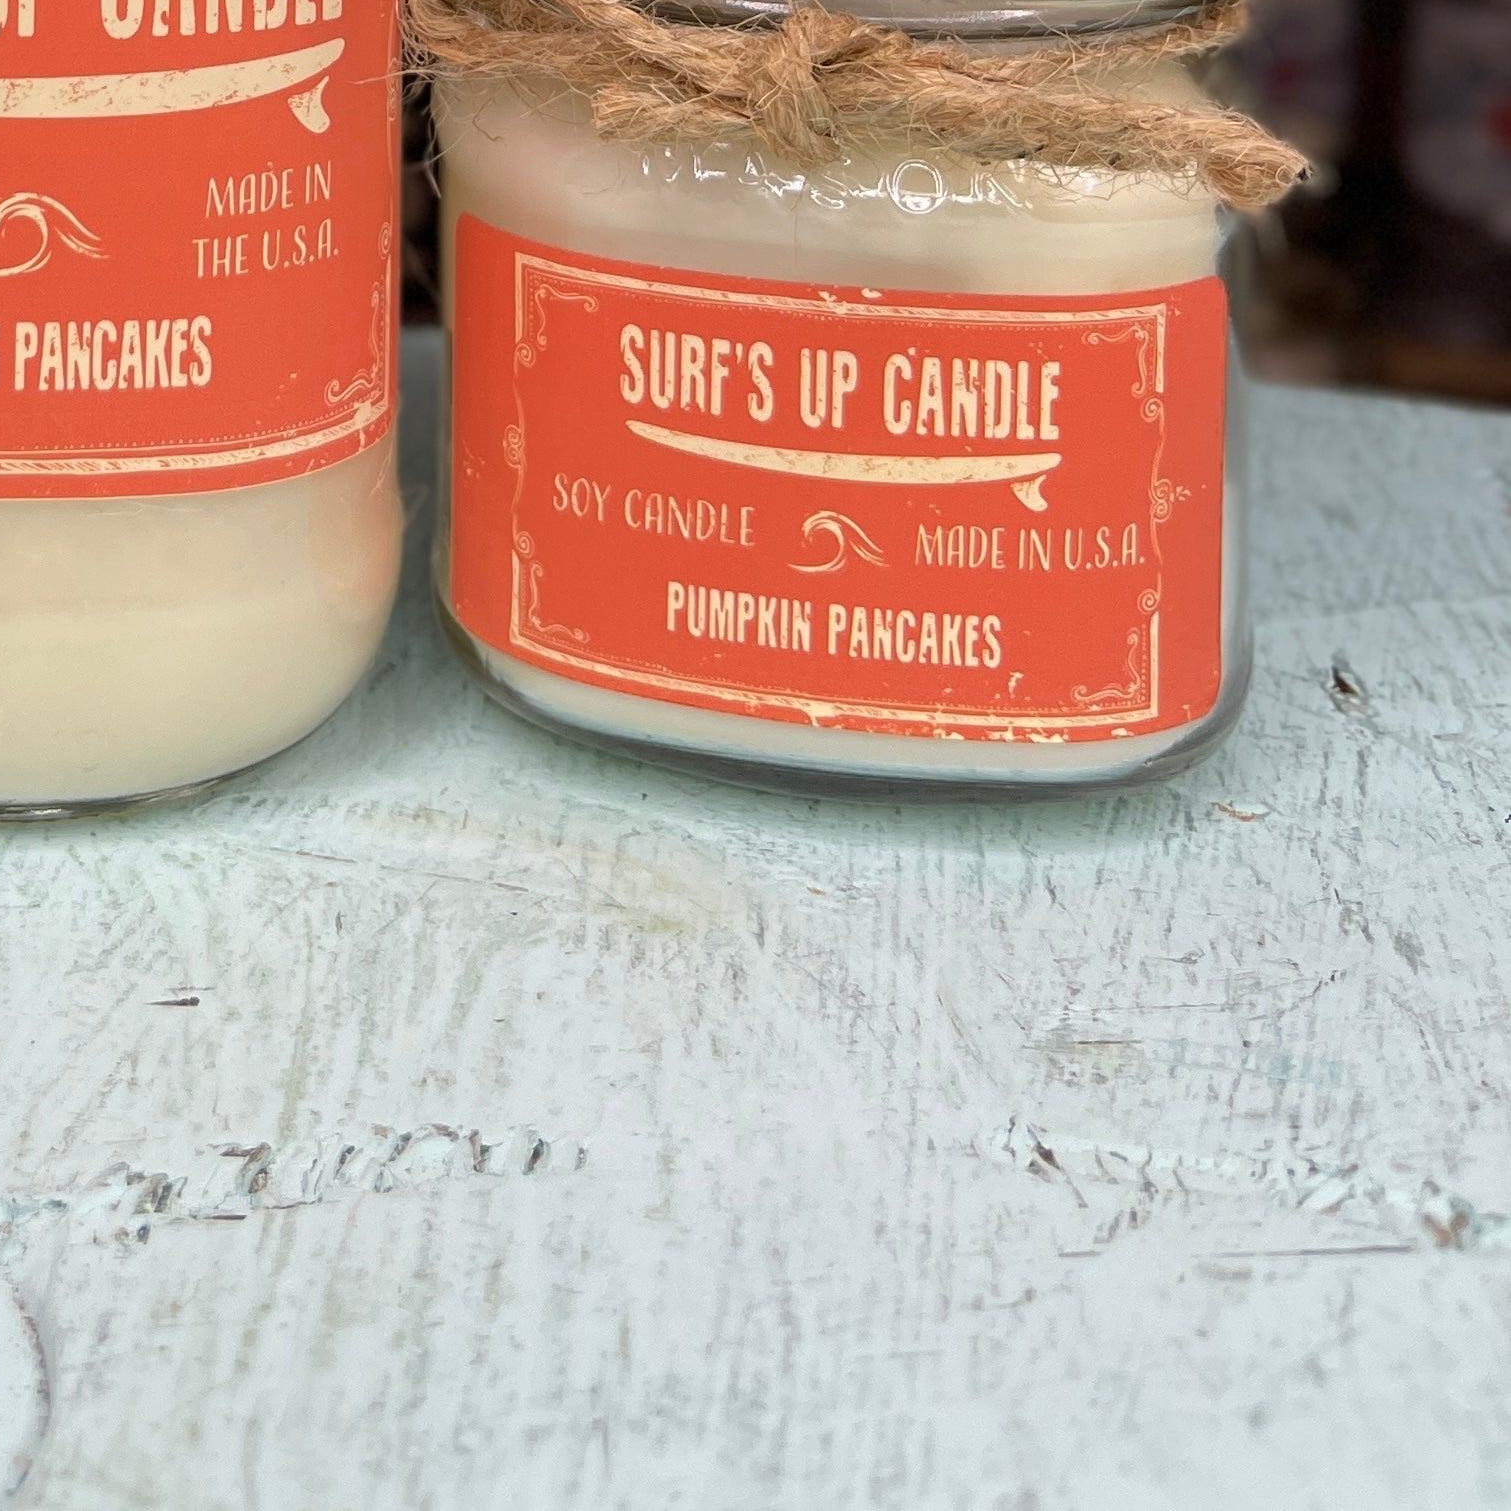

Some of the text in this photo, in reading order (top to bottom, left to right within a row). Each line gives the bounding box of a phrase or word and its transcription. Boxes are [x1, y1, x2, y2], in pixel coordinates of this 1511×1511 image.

[205, 160, 331, 218] MADE IN
[192, 219, 339, 278] THE U.S.A.
[14, 315, 212, 391] PANCAKES
[620, 323, 1061, 441] SURF'S UP CANDLE
[553, 473, 755, 547] SOY CANDLE
[915, 523, 1145, 571] MADE IN U.S.A.
[667, 581, 1001, 669] PUMPKIN PANCAKES
